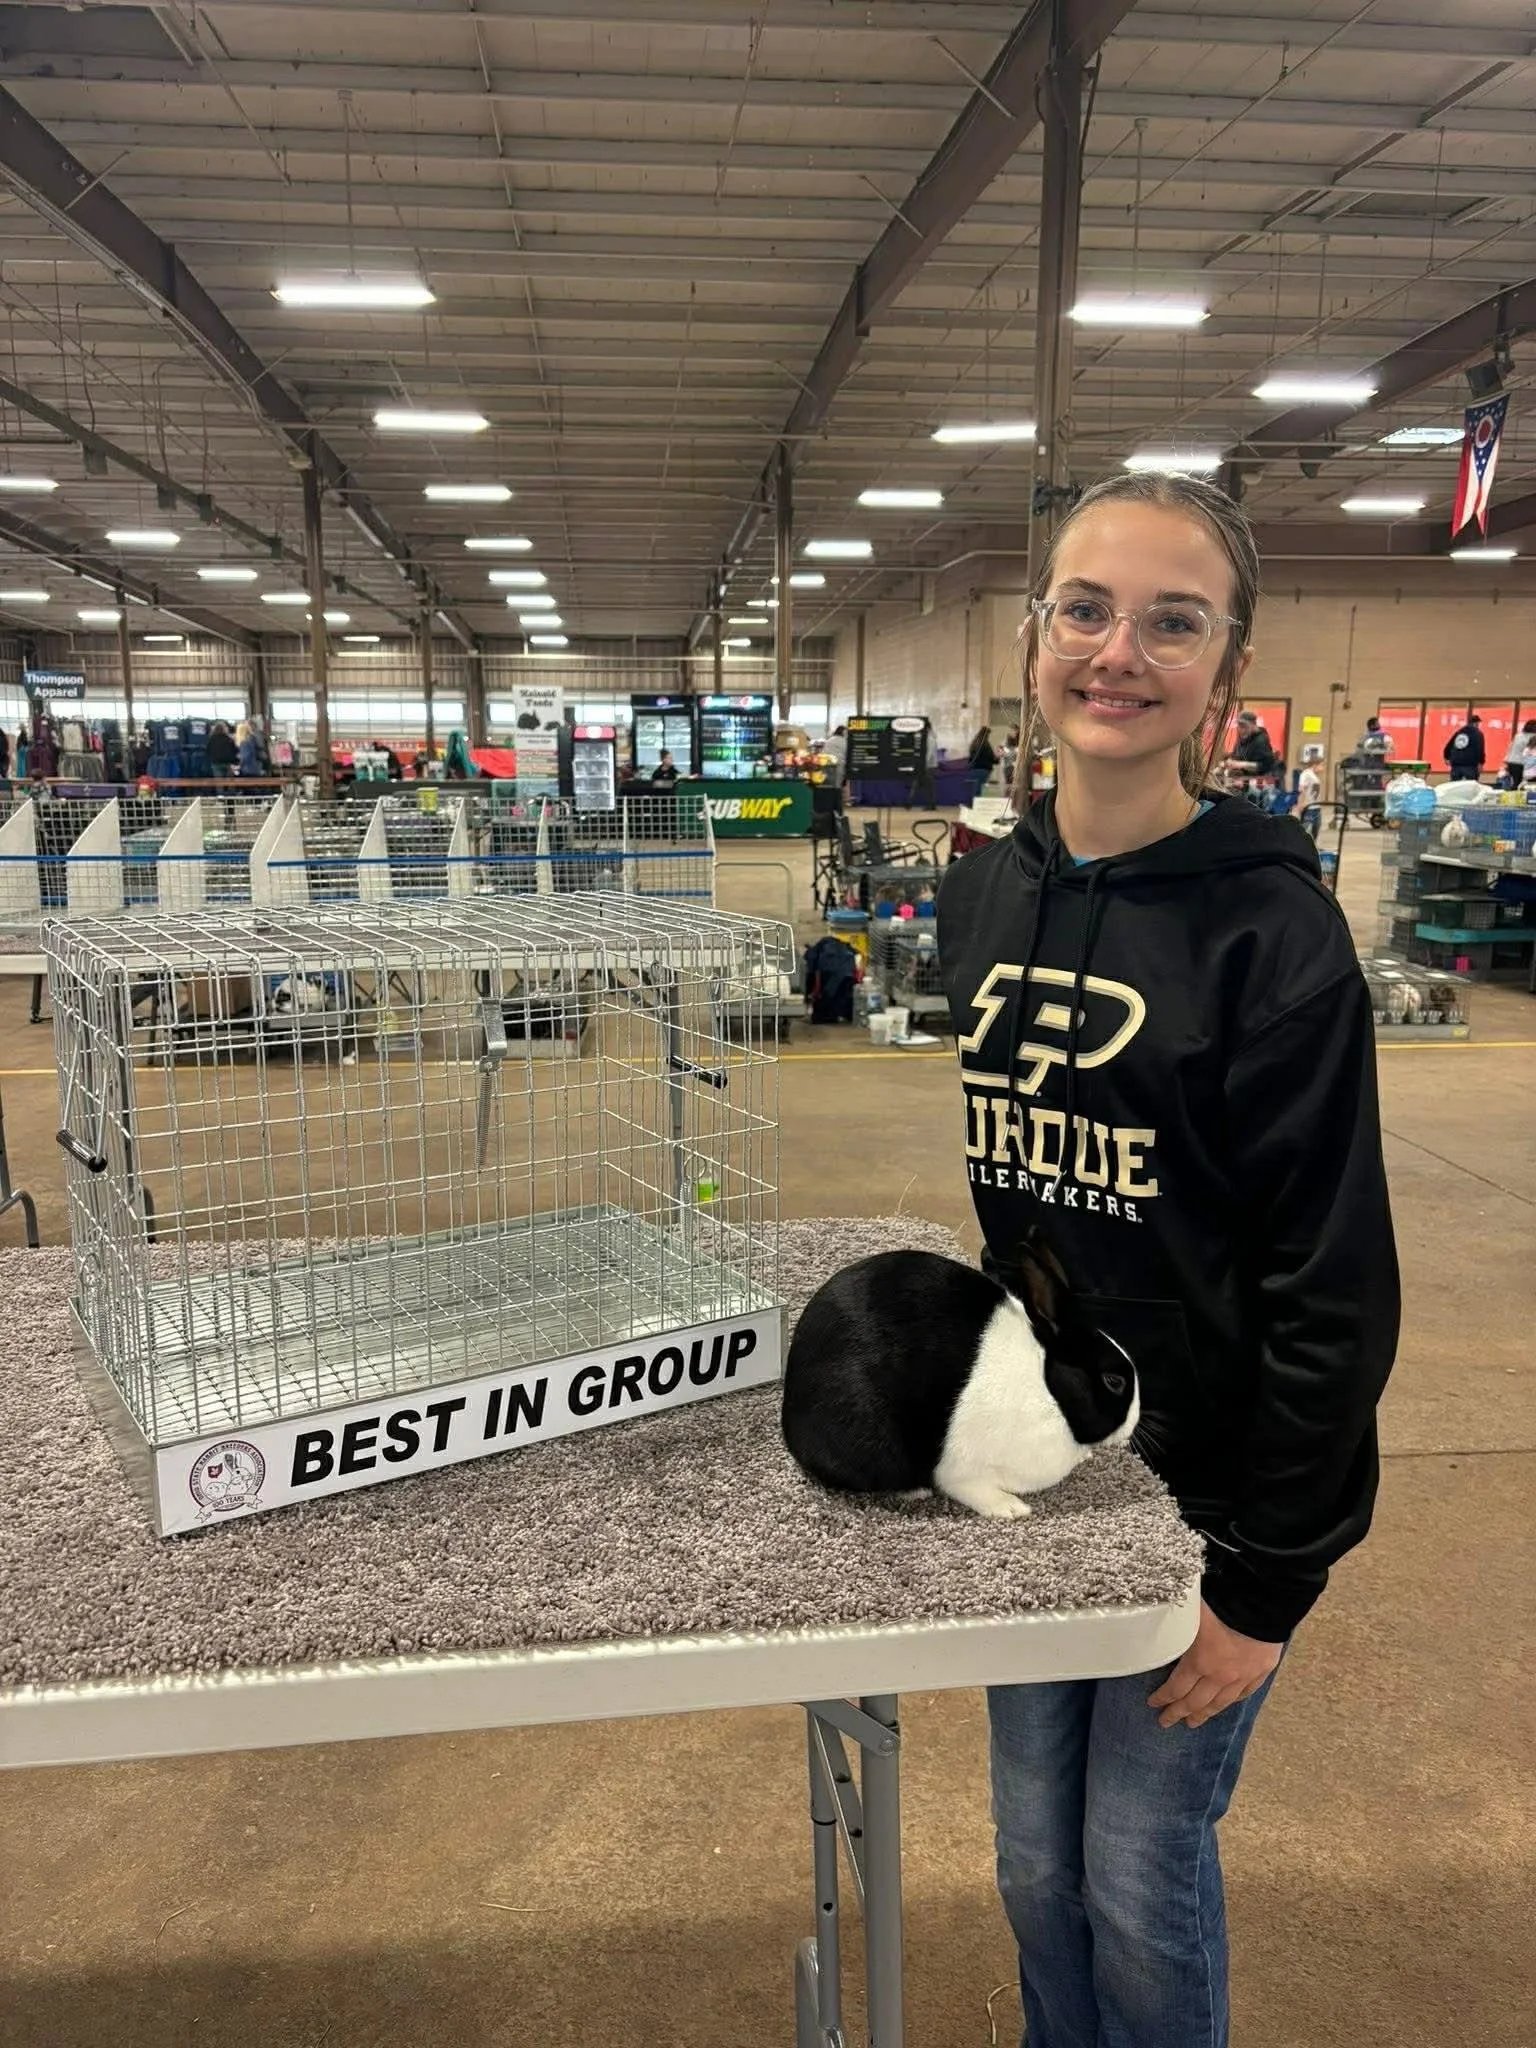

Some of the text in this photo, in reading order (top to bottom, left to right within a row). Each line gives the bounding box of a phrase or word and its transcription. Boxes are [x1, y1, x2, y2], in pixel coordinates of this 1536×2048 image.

[25, 673, 84, 686] Thompson
[34, 687, 78, 698] Apparel
[697, 797, 793, 819] SUBWAY
[963, 1093, 1159, 1198] URDUE
[291, 1328, 758, 1488] BEST IN GROUP
[225, 1495, 245, 1504] YEARS
